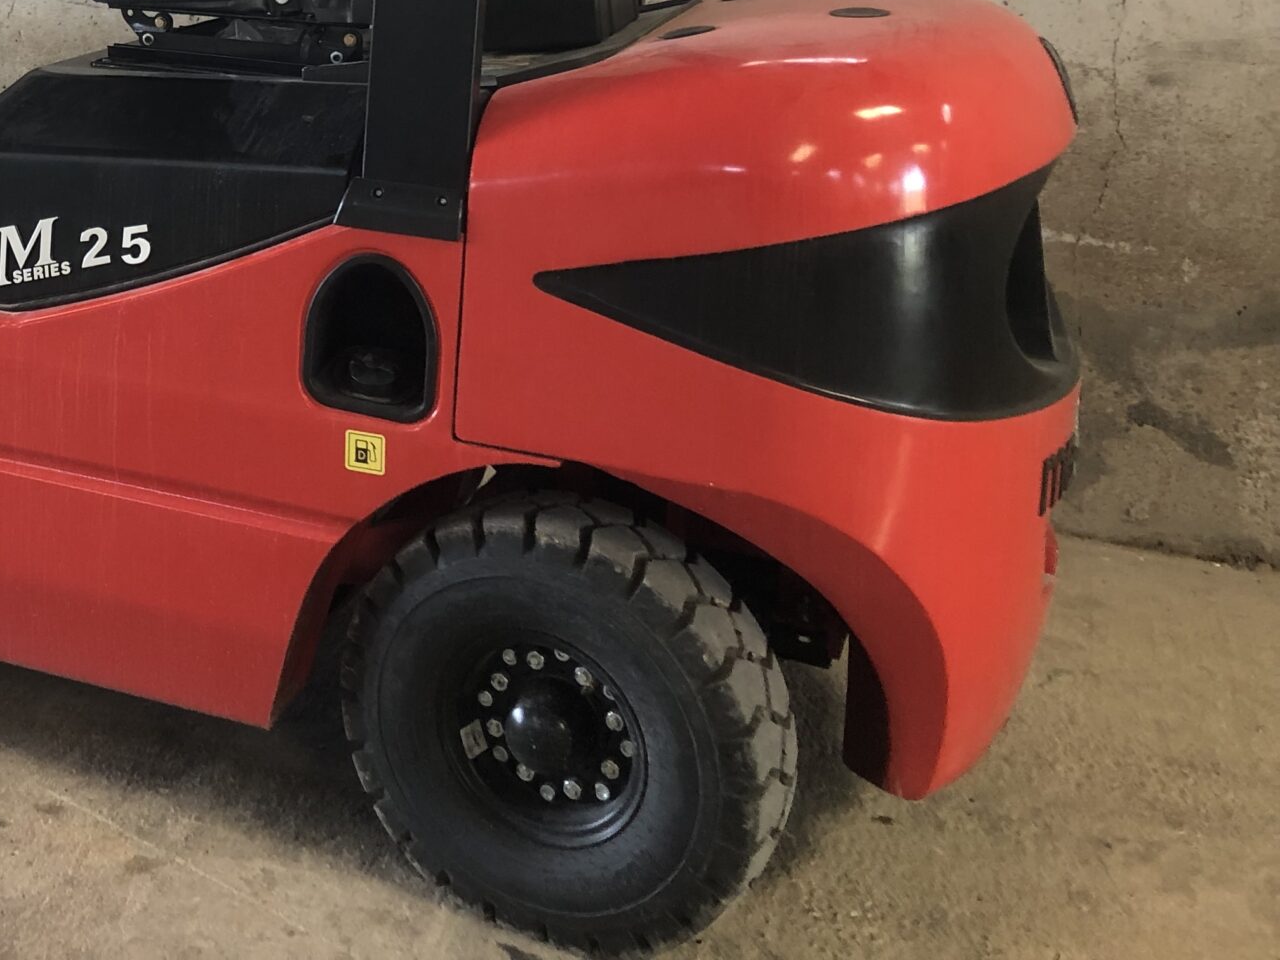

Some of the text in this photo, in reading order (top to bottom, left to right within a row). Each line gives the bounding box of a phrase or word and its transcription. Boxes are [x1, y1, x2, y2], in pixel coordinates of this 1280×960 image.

[80, 223, 151, 269] 25
[12, 261, 71, 284] SERIES
[357, 450, 366, 460] D
